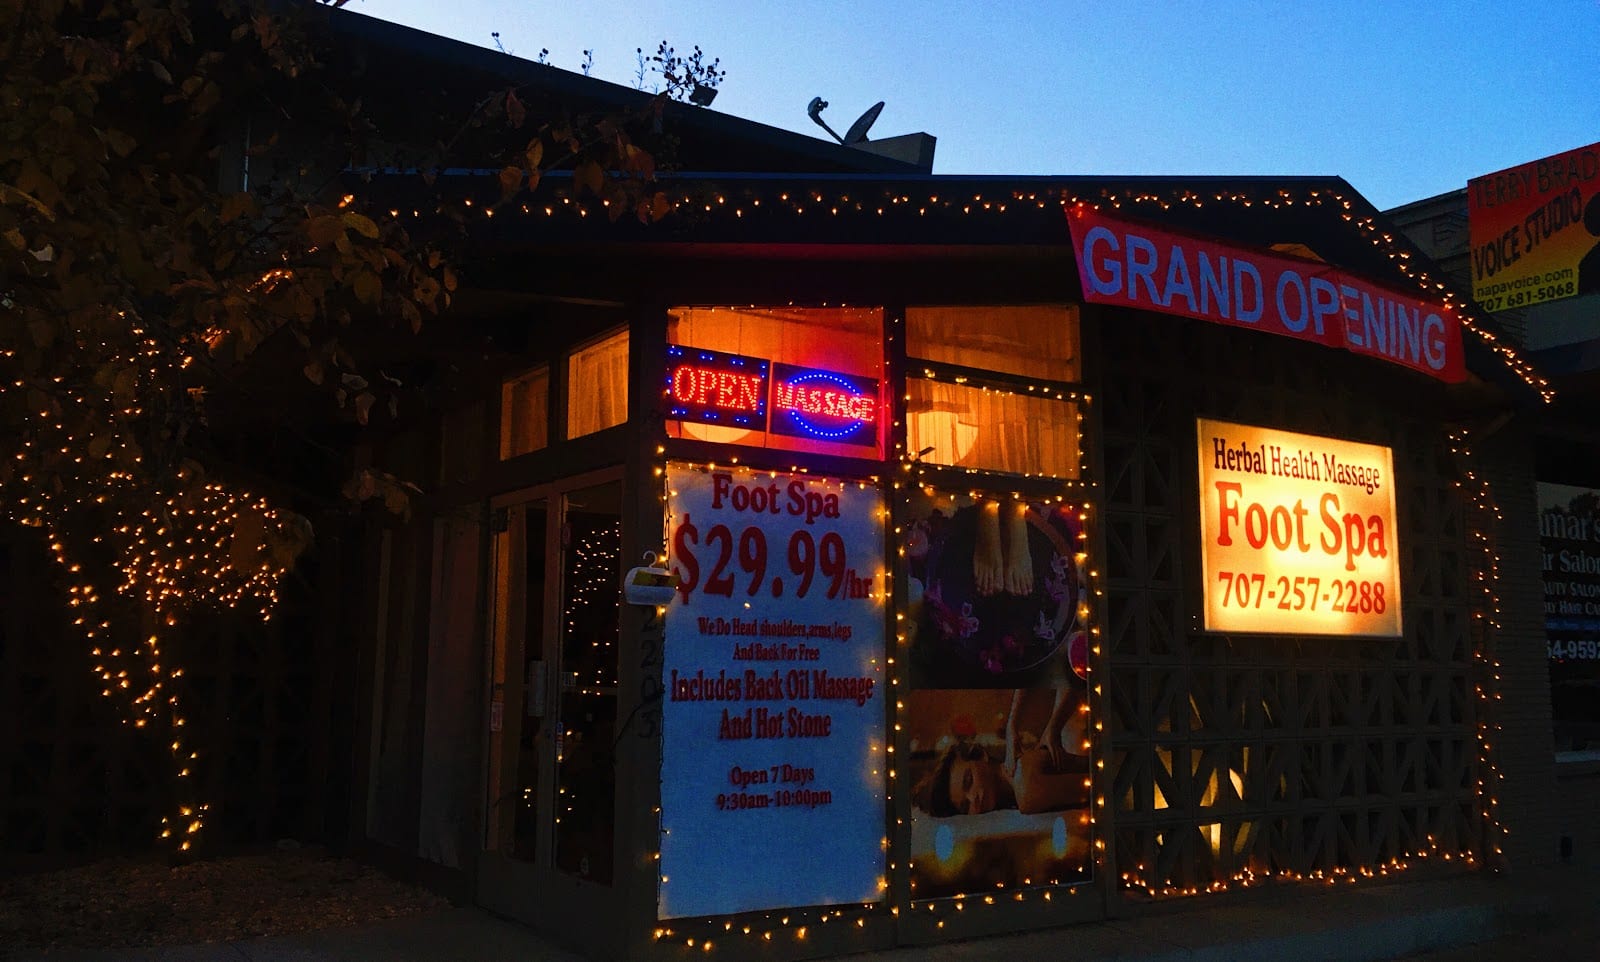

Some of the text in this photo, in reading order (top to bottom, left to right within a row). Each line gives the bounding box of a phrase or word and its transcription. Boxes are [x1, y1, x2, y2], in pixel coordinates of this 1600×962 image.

[1472, 170, 1534, 207] TERRY
[1473, 187, 1582, 281] VOICE STUDIO
[1083, 226, 1447, 370] GRAND OPENING
[1477, 268, 1573, 297] napavoice.com
[1507, 282, 1575, 306] 681-5068
[673, 366, 762, 411] OPEN
[776, 382, 876, 422] MASSAGE
[1213, 438, 1380, 495] Herbal Health Massage
[712, 474, 840, 525] Foot Spa
[1215, 481, 1388, 571] Foot Spa
[1219, 572, 1386, 614] 707-257-2288
[698, 617, 715, 635] We
[717, 617, 730, 636] Do
[732, 618, 757, 636] Head
[733, 643, 820, 661] And Back For Free
[671, 670, 874, 706] Includes Back Oil Massage
[720, 708, 832, 740] And Hot Stone
[729, 764, 815, 789] Open 7 Days
[716, 789, 832, 811] 9:30am-10:00pm
